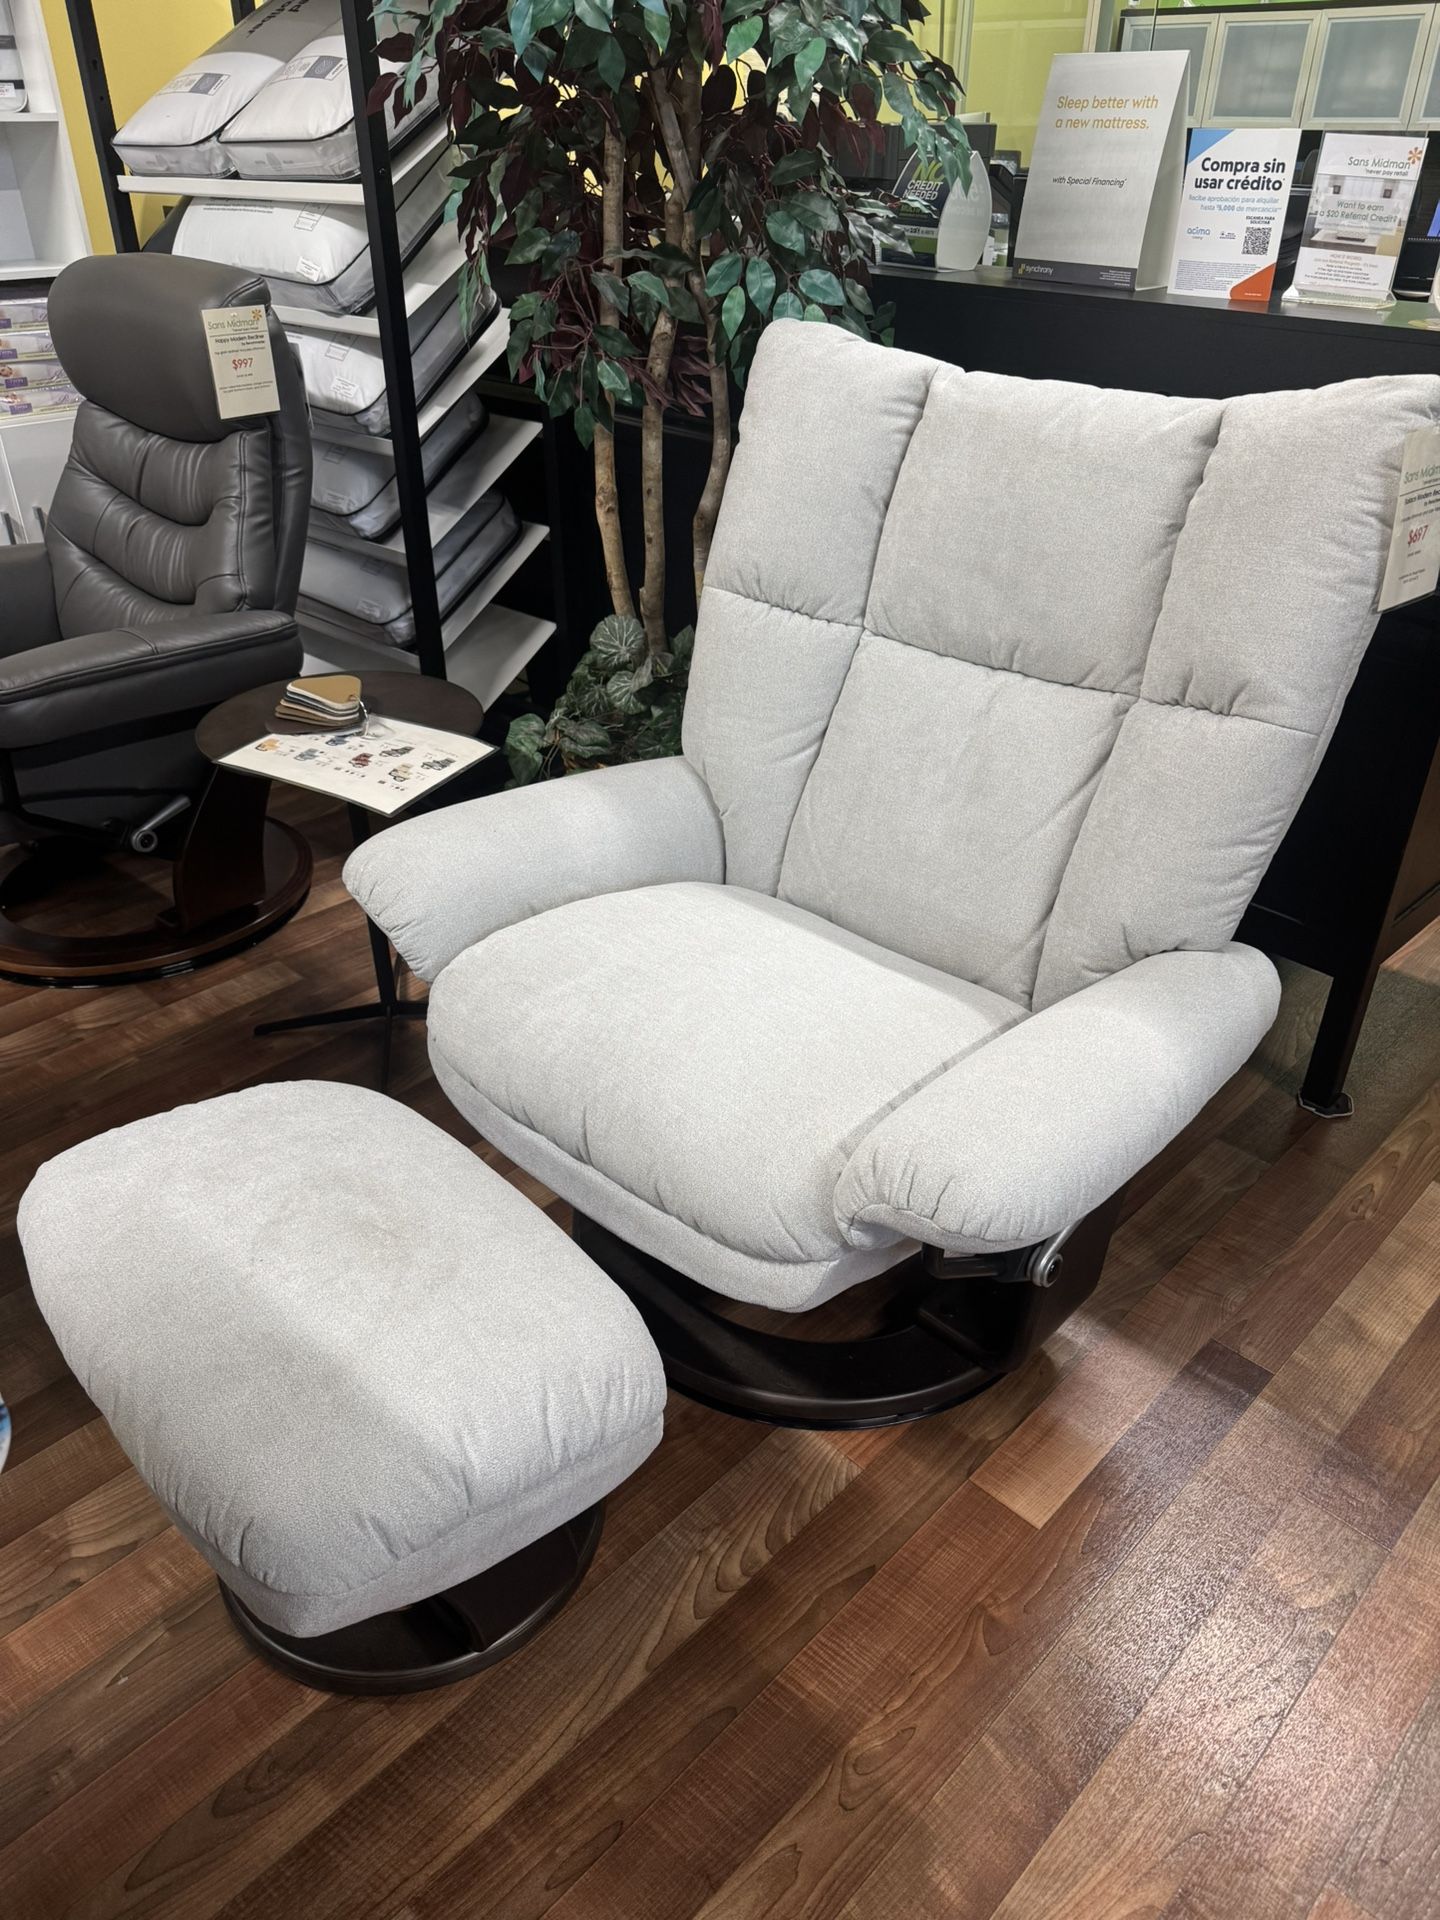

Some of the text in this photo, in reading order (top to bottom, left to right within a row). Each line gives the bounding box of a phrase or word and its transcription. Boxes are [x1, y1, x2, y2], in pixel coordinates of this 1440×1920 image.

[1057, 95, 1159, 112] Sleep better with
[1055, 117, 1150, 130] a new mattress.
[1201, 157, 1286, 176] Compra sin
[1347, 156, 1411, 170] Sans Midman
[907, 180, 943, 191] CREDIT
[1052, 176, 1066, 185] with
[1067, 176, 1091, 187] Special
[1194, 177, 1224, 190] usar
[902, 188, 938, 200] NEEDED
[1241, 196, 1256, 204] para
[1336, 200, 1384, 212] Want to earn
[1326, 210, 1339, 219] $20
[1340, 210, 1369, 220] Referral
[1370, 213, 1398, 223] Credit?
[1187, 226, 1211, 236] acima
[1025, 264, 1053, 275] synchrony
[208, 321, 225, 330] Sans
[227, 319, 258, 329] Midman
[232, 358, 253, 370] $997
[1404, 471, 1419, 484] Sans
[1408, 524, 1428, 547] $697
